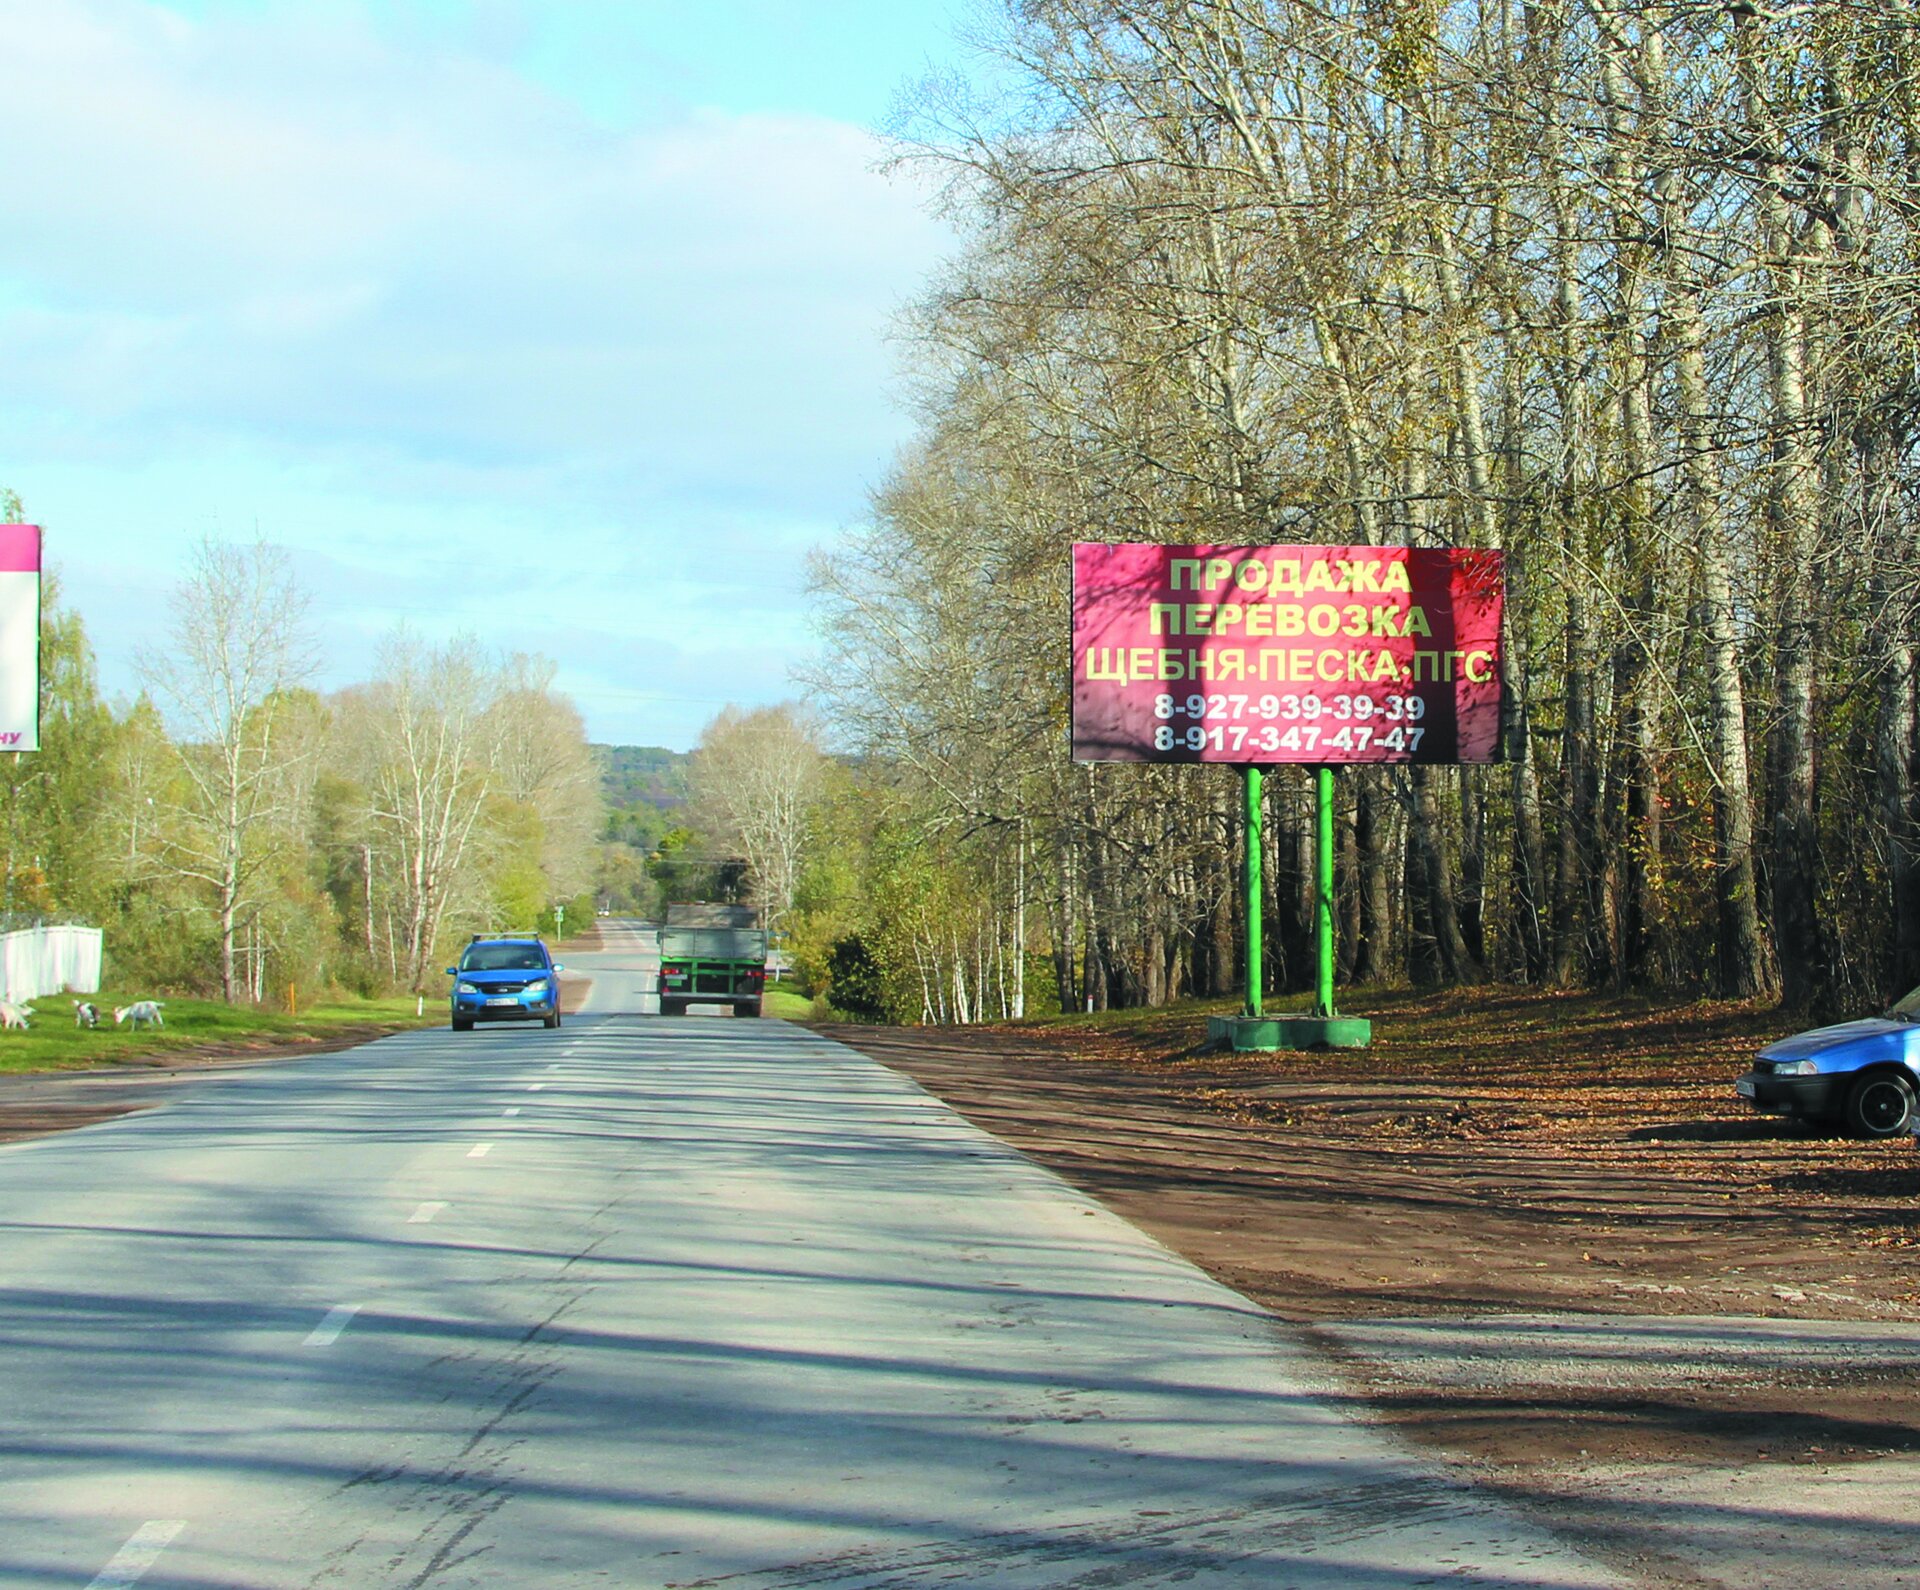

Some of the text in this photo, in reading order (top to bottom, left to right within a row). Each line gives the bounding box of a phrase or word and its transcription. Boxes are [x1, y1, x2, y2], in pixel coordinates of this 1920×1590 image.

[1170, 559, 1413, 597] ПРОДАЖА
[1149, 604, 1431, 637] ПЕРЕВОЗКА
[1154, 695, 1425, 720] 8-927-939-39-39
[1154, 727, 1424, 751] 8-917-347-47-47
